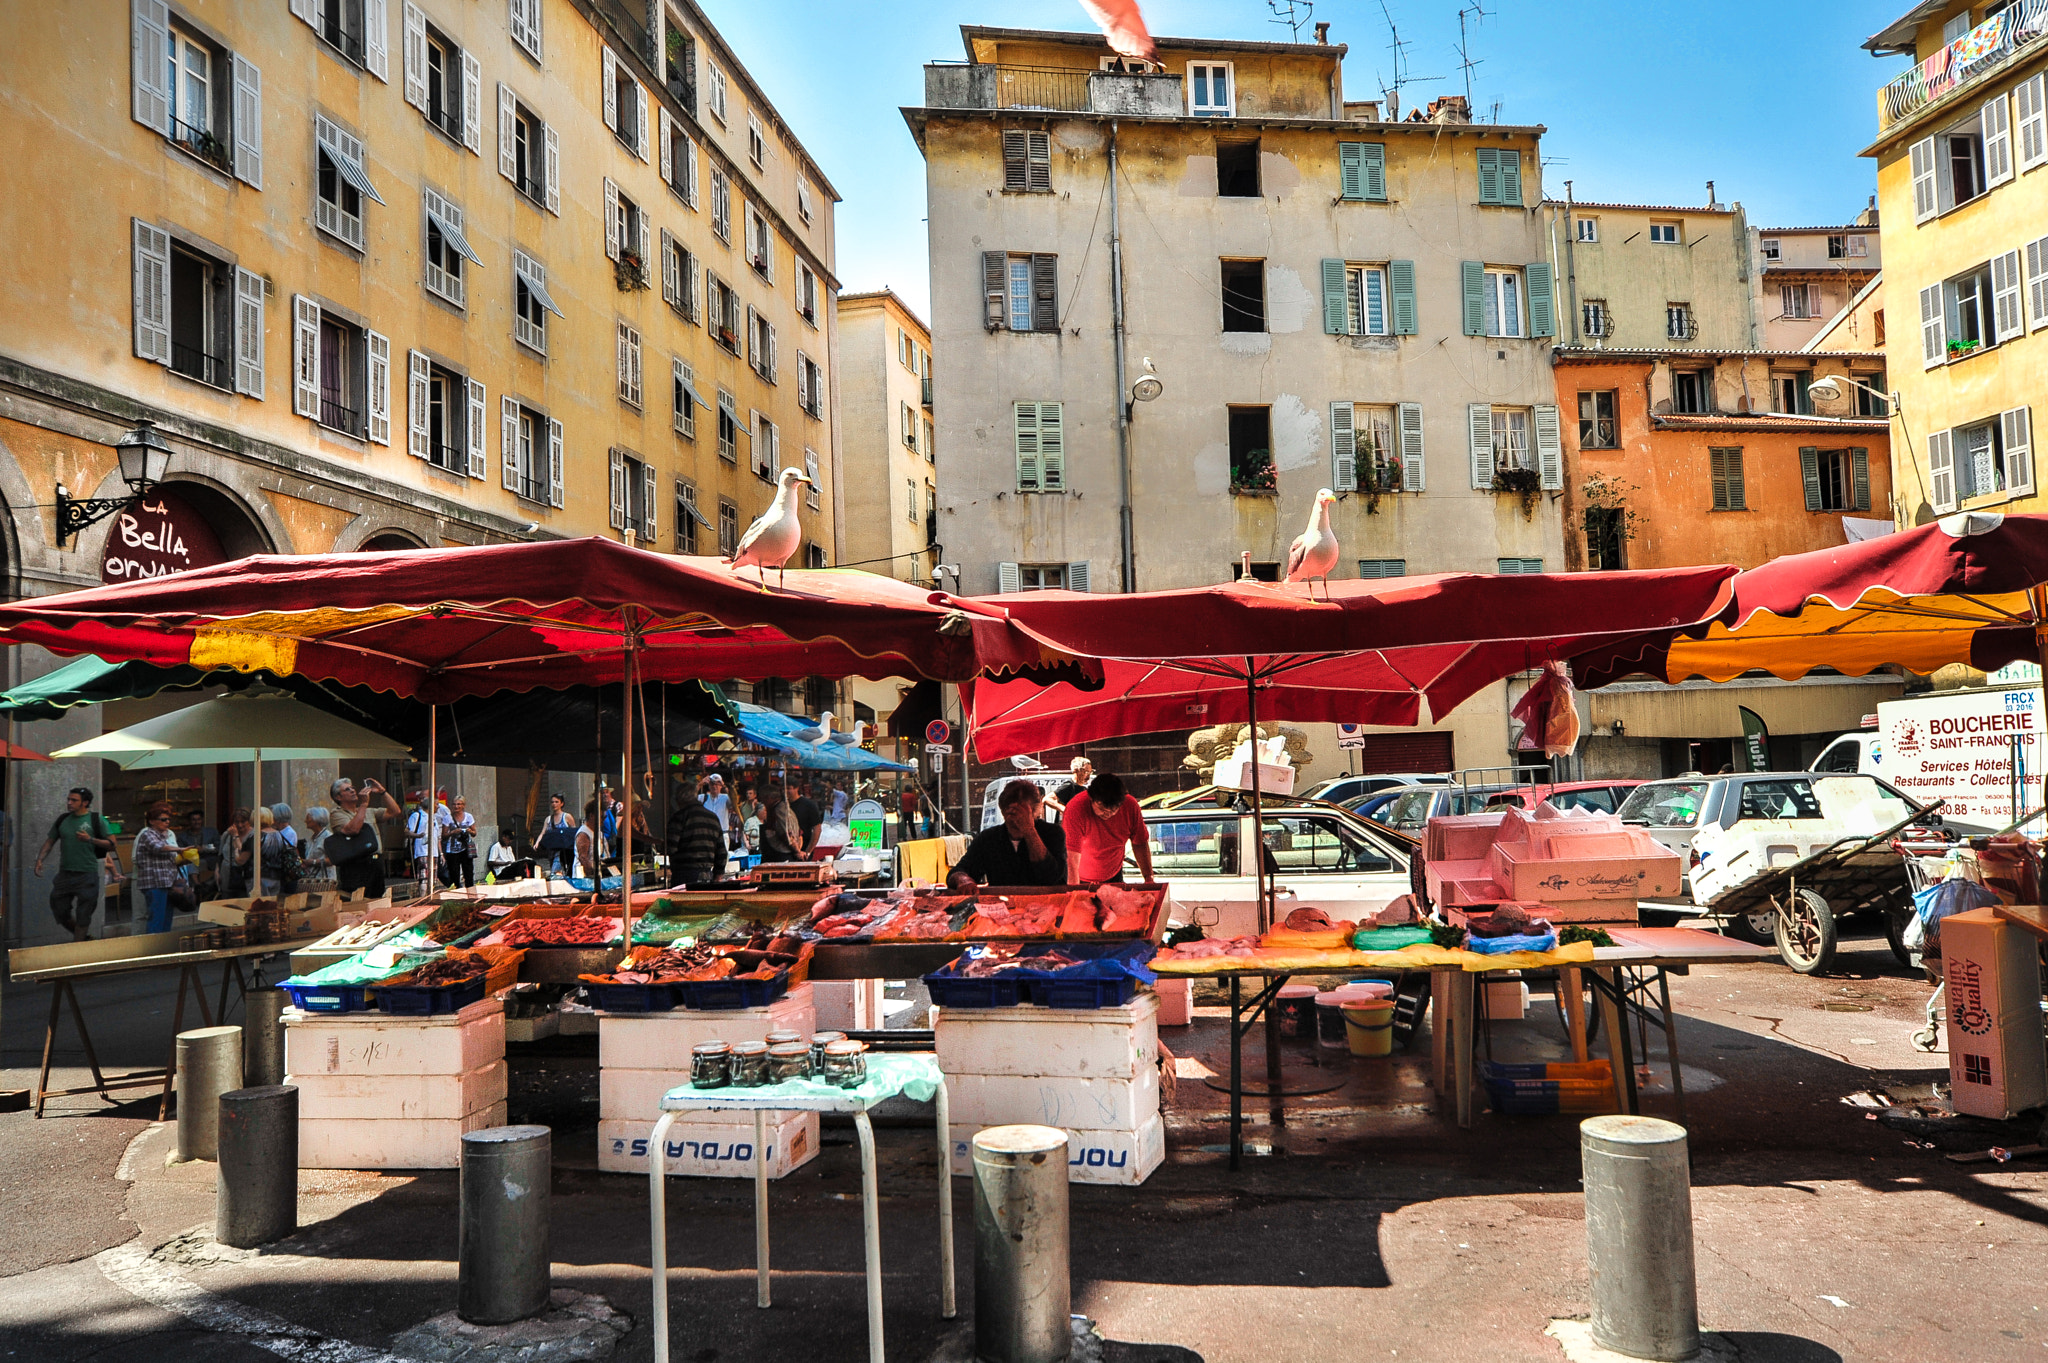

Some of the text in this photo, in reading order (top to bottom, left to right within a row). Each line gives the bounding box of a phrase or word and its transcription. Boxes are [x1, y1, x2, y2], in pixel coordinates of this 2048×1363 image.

[142, 501, 168, 515] LA
[2005, 692, 2035, 704] FRCX
[1929, 713, 2034, 735] BOUCHERIE
[1930, 733, 2035, 749] SAINT-FRANÇIS
[1920, 758, 2012, 773] Services Hôtels
[1894, 774, 1955, 787] Restaurants
[1962, 958, 1985, 1027] Quality
